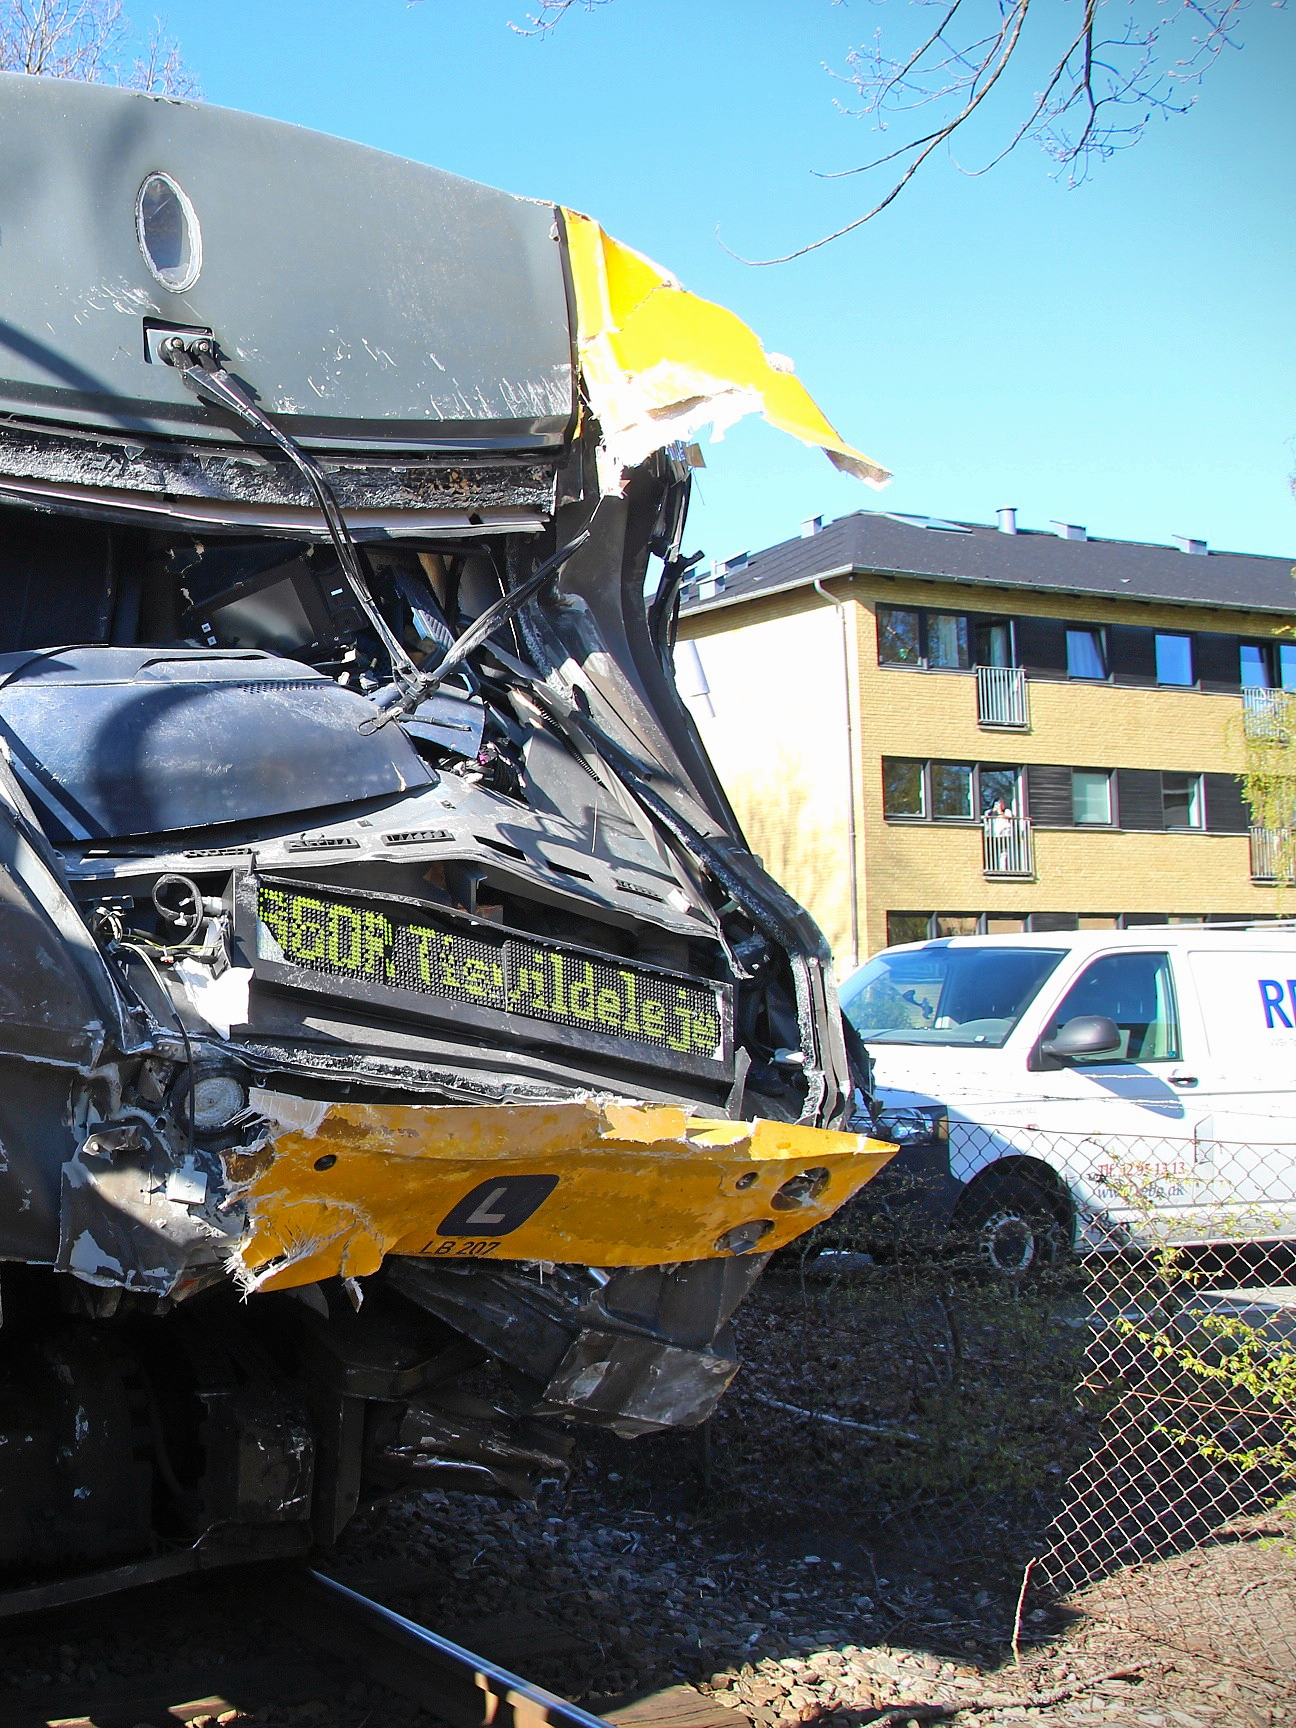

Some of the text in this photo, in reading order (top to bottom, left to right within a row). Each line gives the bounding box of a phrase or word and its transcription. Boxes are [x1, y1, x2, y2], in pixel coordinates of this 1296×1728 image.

[466, 1187, 507, 1224] L
[418, 1240, 502, 1256] LB 207
